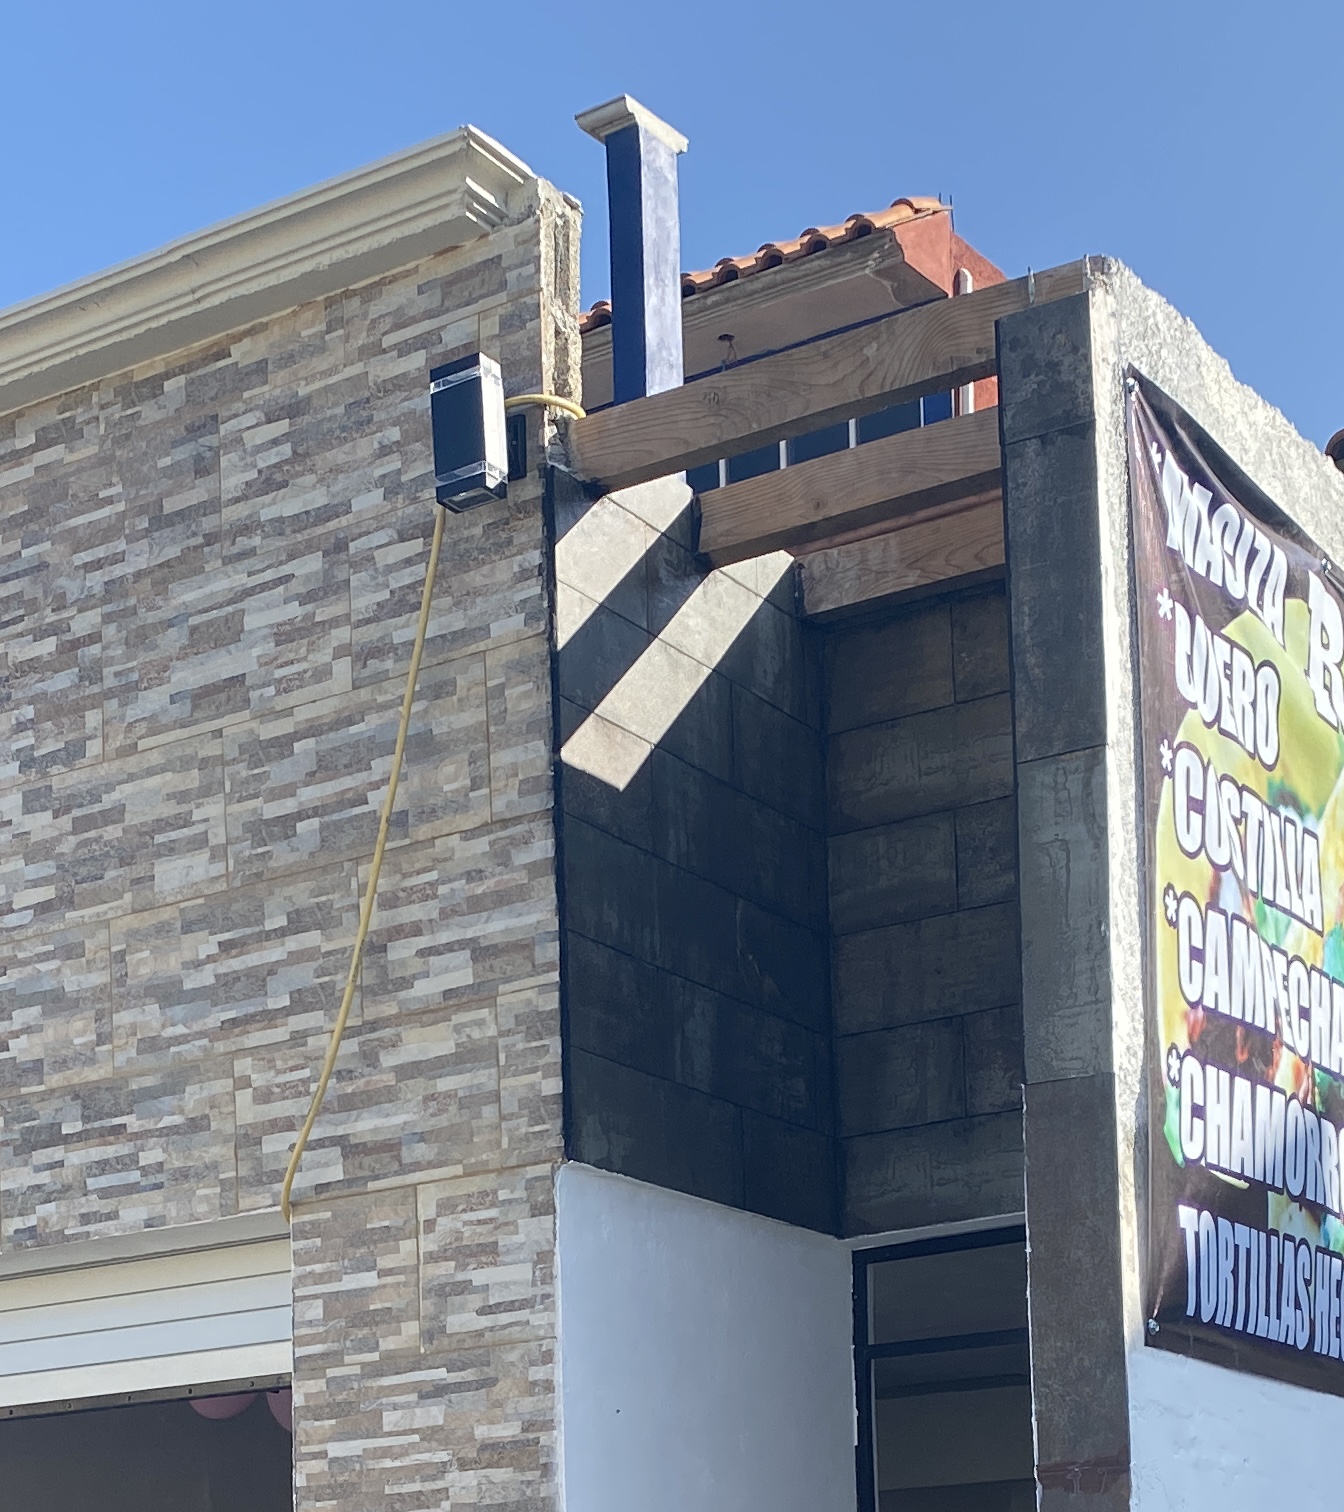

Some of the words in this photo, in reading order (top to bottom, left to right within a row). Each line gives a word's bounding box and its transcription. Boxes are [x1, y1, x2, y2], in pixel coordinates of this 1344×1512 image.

[1173, 601, 1280, 767] CUERO
[1174, 745, 1325, 935] COSTILLA
[1178, 1204, 1311, 1350] TORTILLAS
